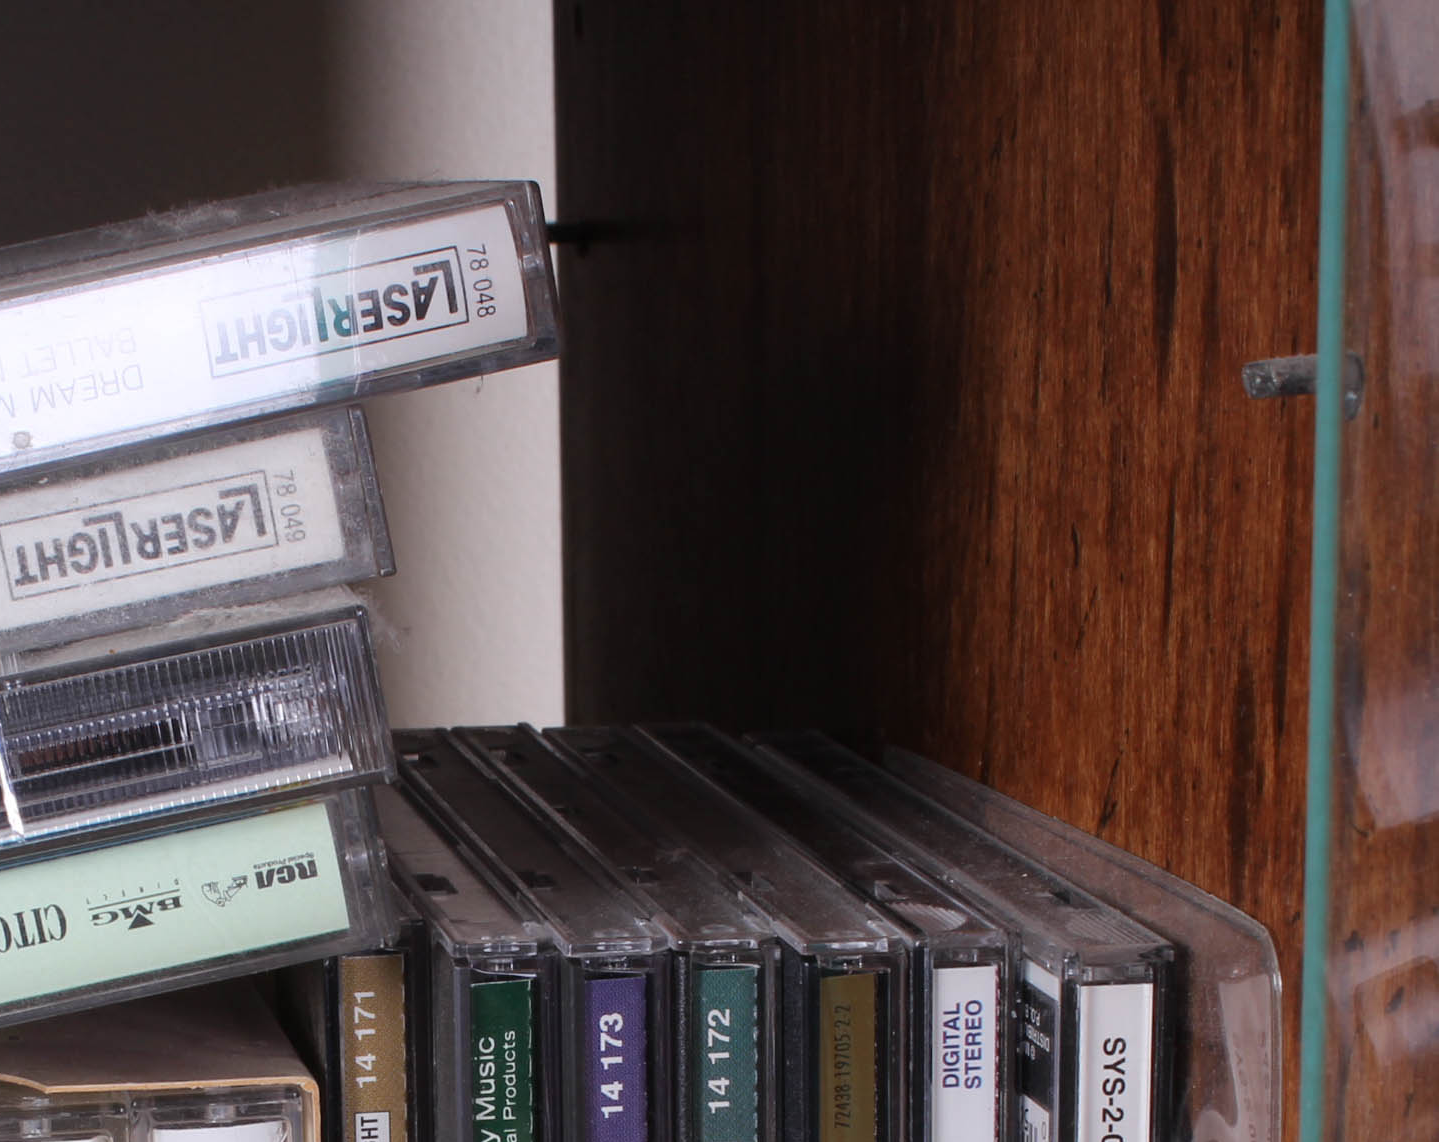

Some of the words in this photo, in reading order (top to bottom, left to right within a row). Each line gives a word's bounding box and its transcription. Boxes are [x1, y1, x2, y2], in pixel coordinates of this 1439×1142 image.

[466, 243, 490, 272] 78
[473, 278, 496, 319] 048
[32, 364, 145, 414] DREAM
[272, 470, 298, 498] 78
[279, 503, 306, 543] 049
[254, 859, 318, 889] RCA
[91, 895, 183, 927] BMG
[354, 991, 376, 1040] 171
[707, 1008, 730, 1064] 172
[600, 1012, 623, 1069] 173
[942, 1003, 961, 1088] DIGITAL
[965, 999, 983, 1090] STEREO
[355, 1054, 378, 1088] 14
[475, 1036, 497, 1121] Music
[503, 1030, 517, 1121] Products
[601, 1084, 624, 1118] 14
[709, 1077, 730, 1114] 14
